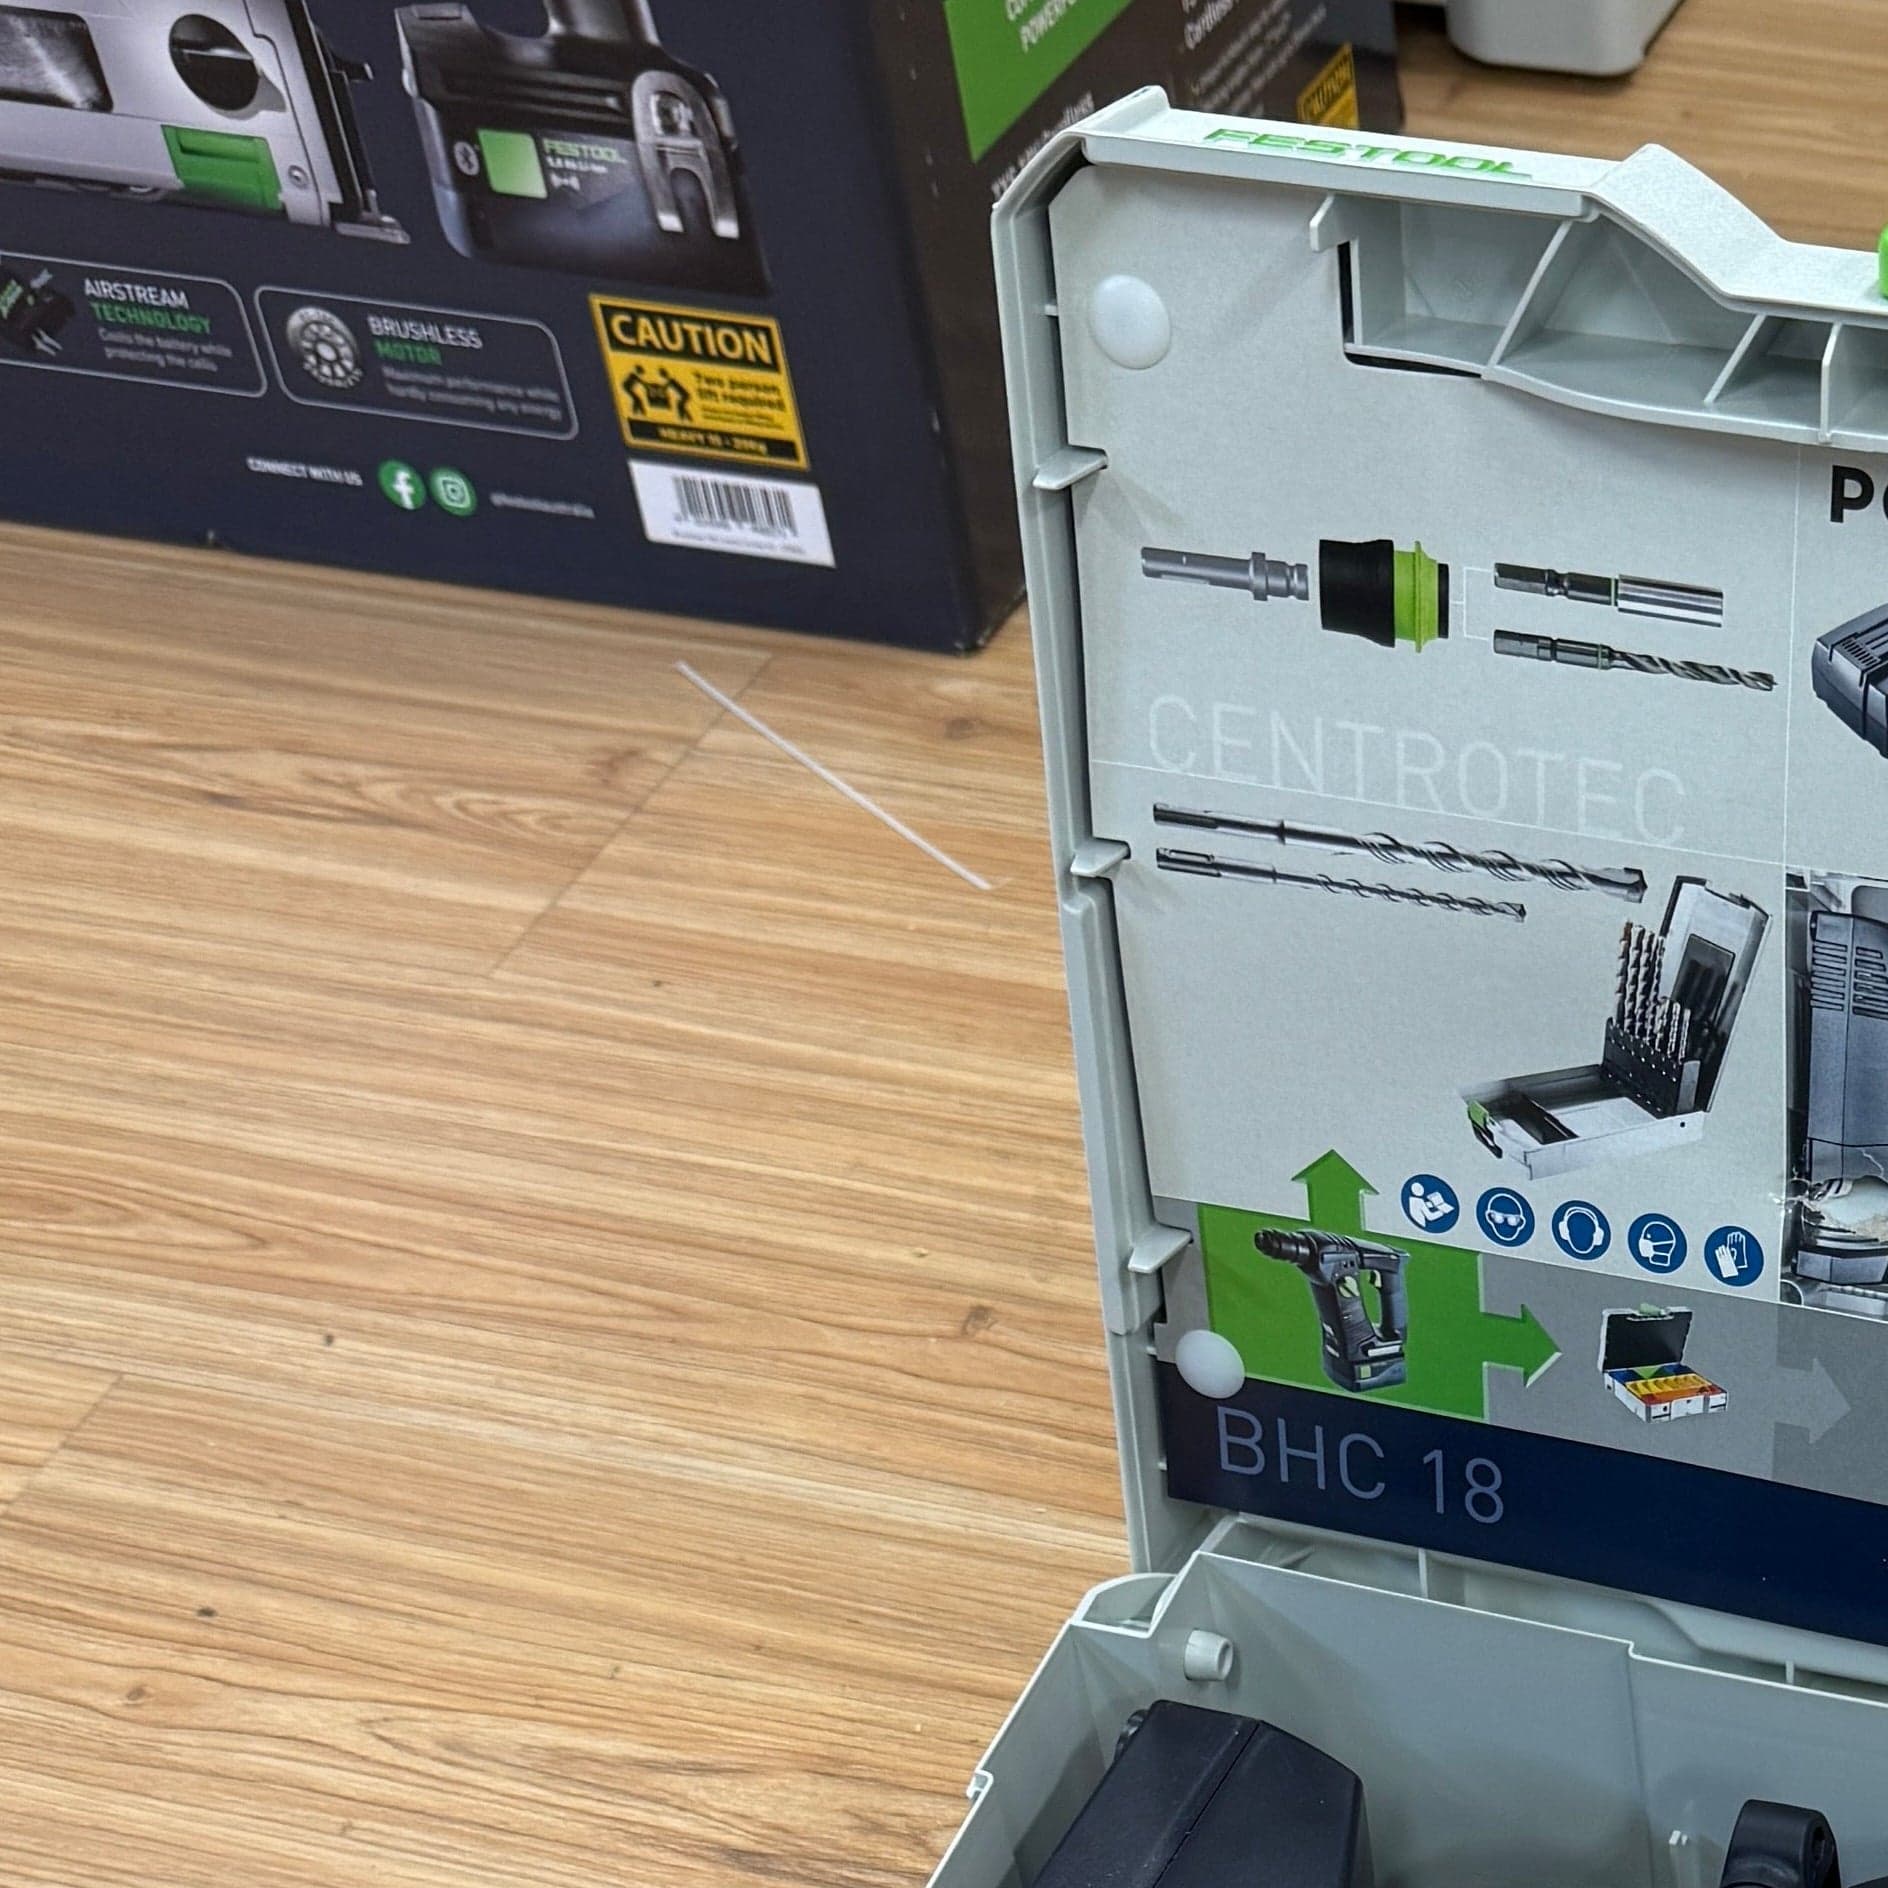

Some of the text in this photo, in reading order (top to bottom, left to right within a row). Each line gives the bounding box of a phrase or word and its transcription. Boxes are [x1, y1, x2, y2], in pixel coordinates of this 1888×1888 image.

[1204, 127, 1532, 181] FESTOOL
[84, 277, 190, 310] AIRSTREAM
[89, 301, 211, 335] TECHNOLOGY
[367, 314, 483, 349] BRUSHLESS
[610, 313, 774, 366] CAUTION
[373, 340, 443, 367] MOTOR
[1148, 694, 1688, 847] CENTROTEC
[1215, 1405, 1505, 1525] BHC 18
